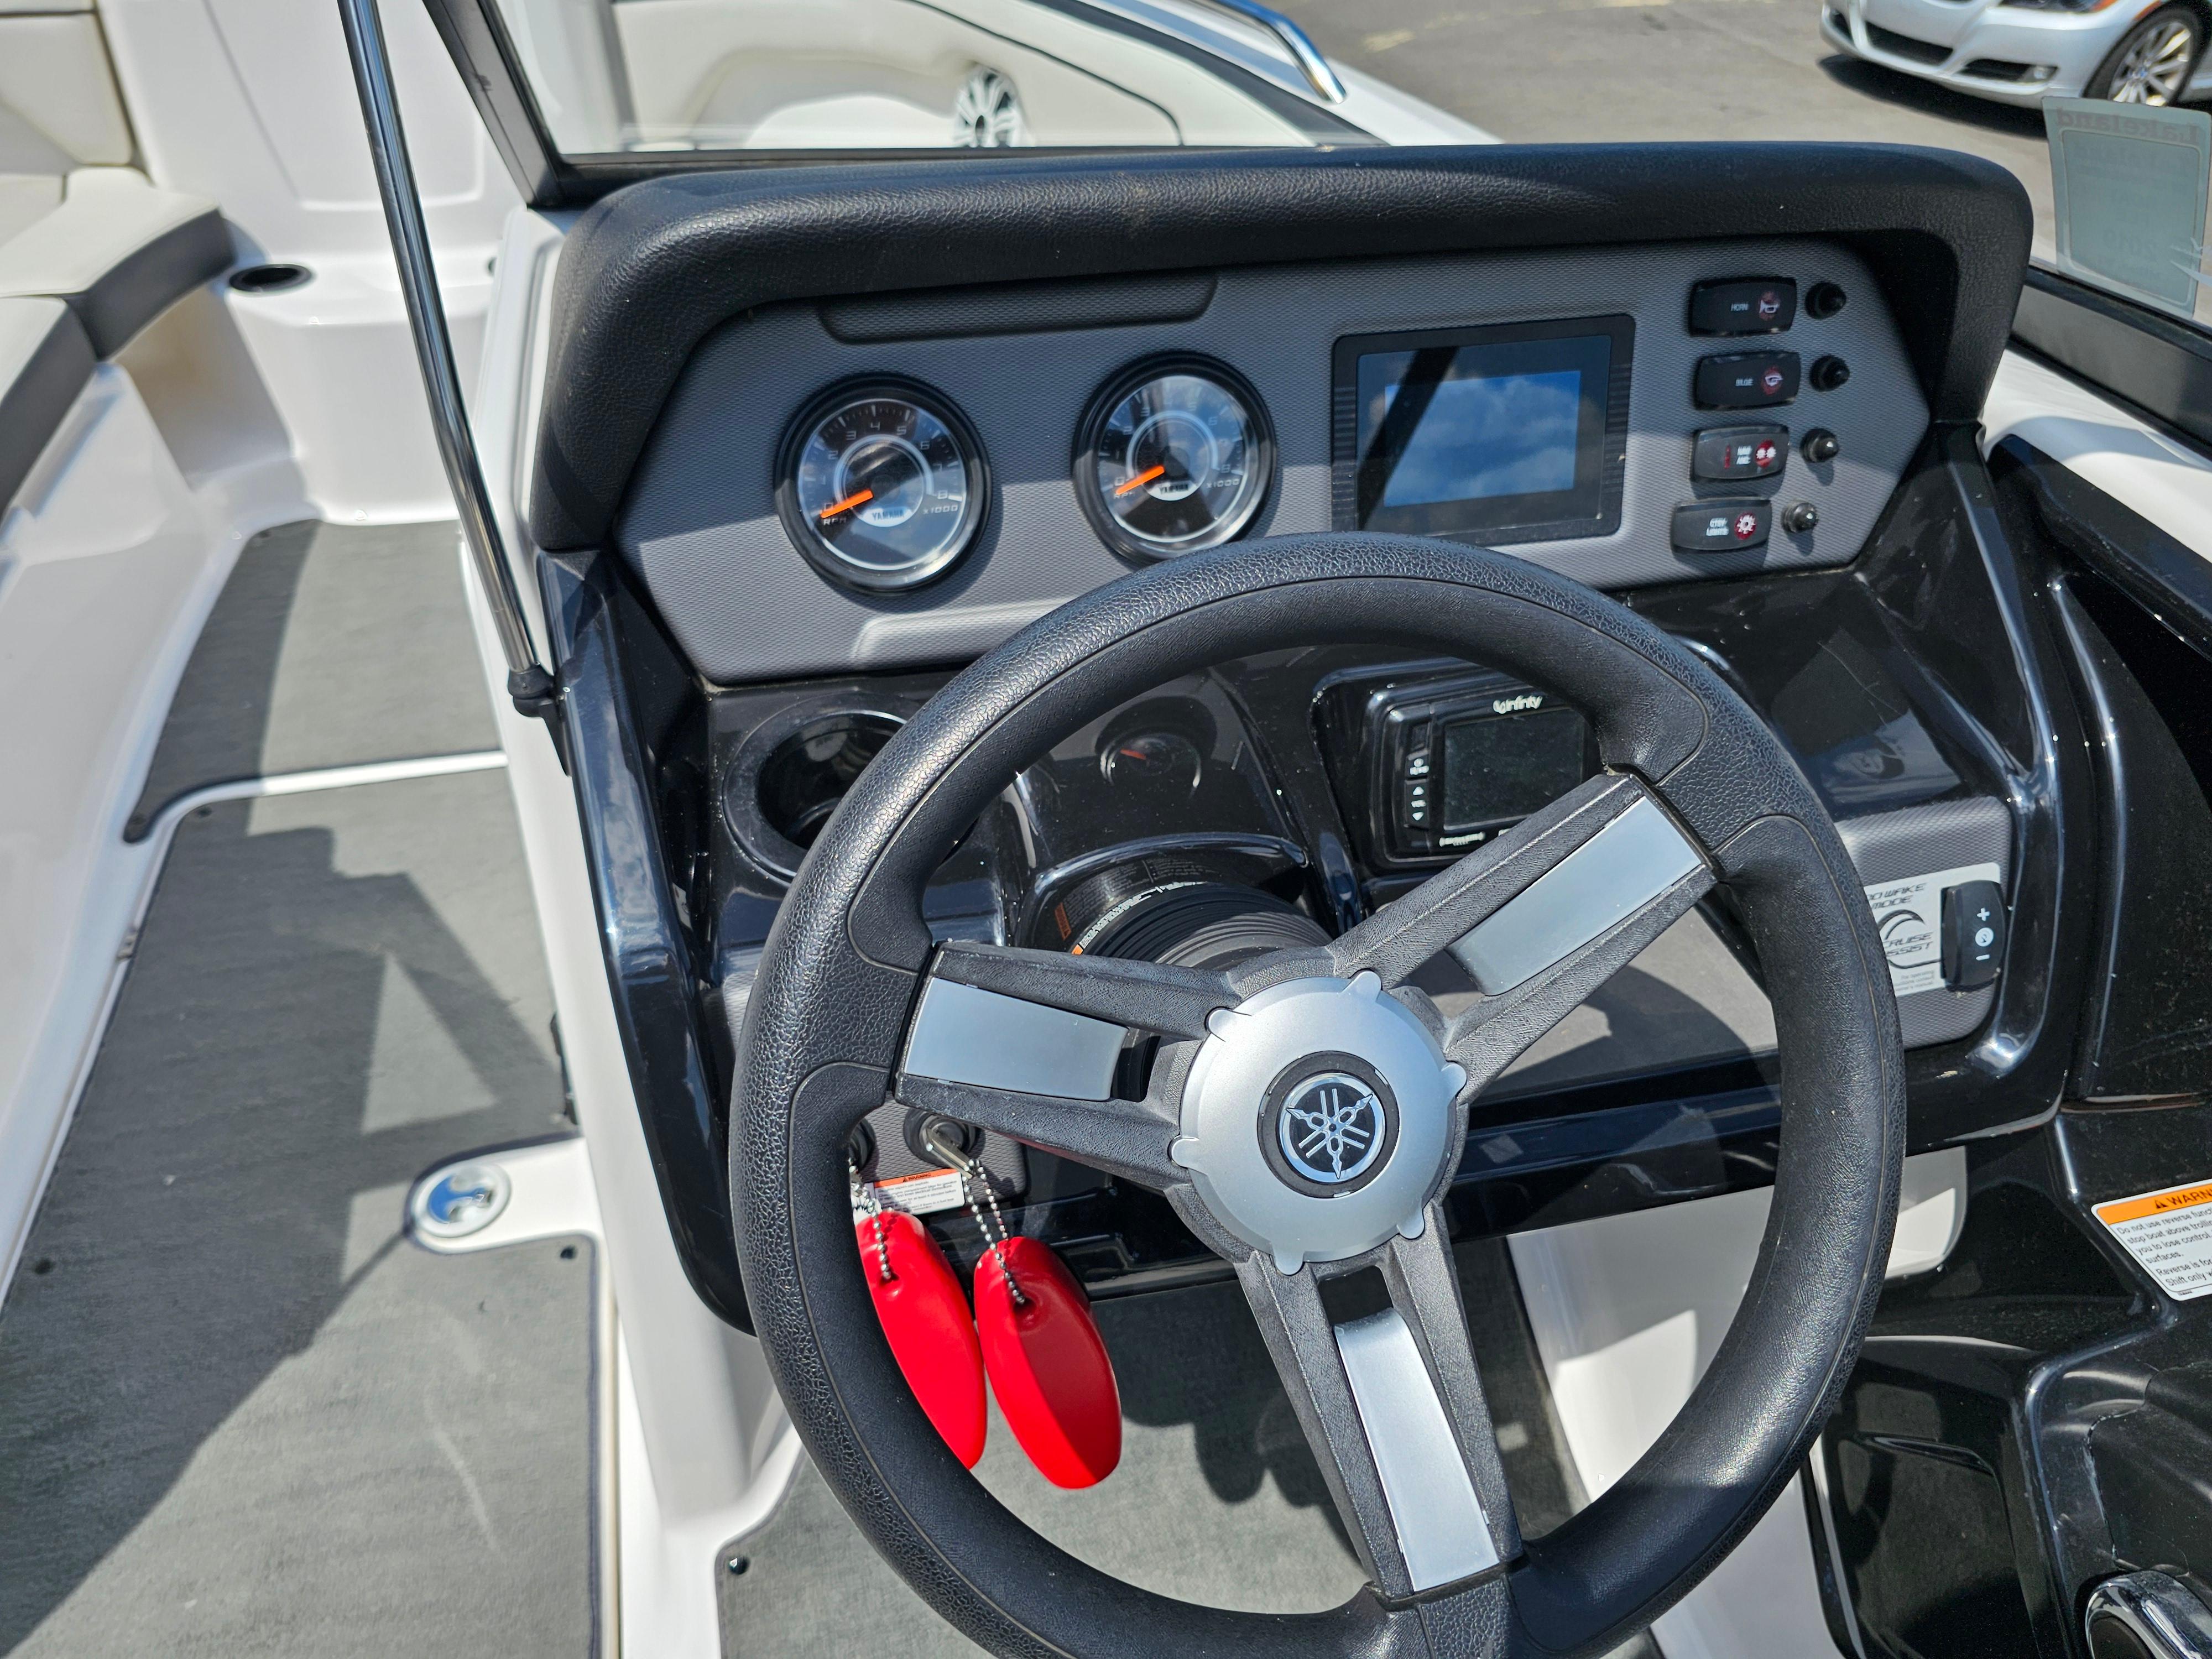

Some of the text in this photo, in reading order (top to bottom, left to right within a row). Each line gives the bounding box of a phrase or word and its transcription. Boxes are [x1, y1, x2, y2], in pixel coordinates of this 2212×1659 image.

[870, 421, 880, 430] 4
[897, 426, 906, 435] 5
[846, 431, 856, 440] 3
[920, 441, 930, 450] 6
[828, 451, 838, 460] 2
[937, 490, 948, 499] 8
[1884, 883, 1927, 898] WAKE
[1872, 895, 1913, 909] MODE
[2162, 1214, 2192, 1224] reverse
[2127, 1236, 2146, 1244] stop
[2145, 1230, 2166, 1239] boat
[2166, 1226, 2191, 1235] above
[2136, 1245, 2152, 1256] you
[2161, 1239, 2181, 1248] lose
[2145, 1251, 2184, 1264] surfaces.
[2156, 1264, 2191, 1276] Reverse
[2165, 1276, 2188, 1286] Shift
[2188, 1272, 2207, 1281] only
